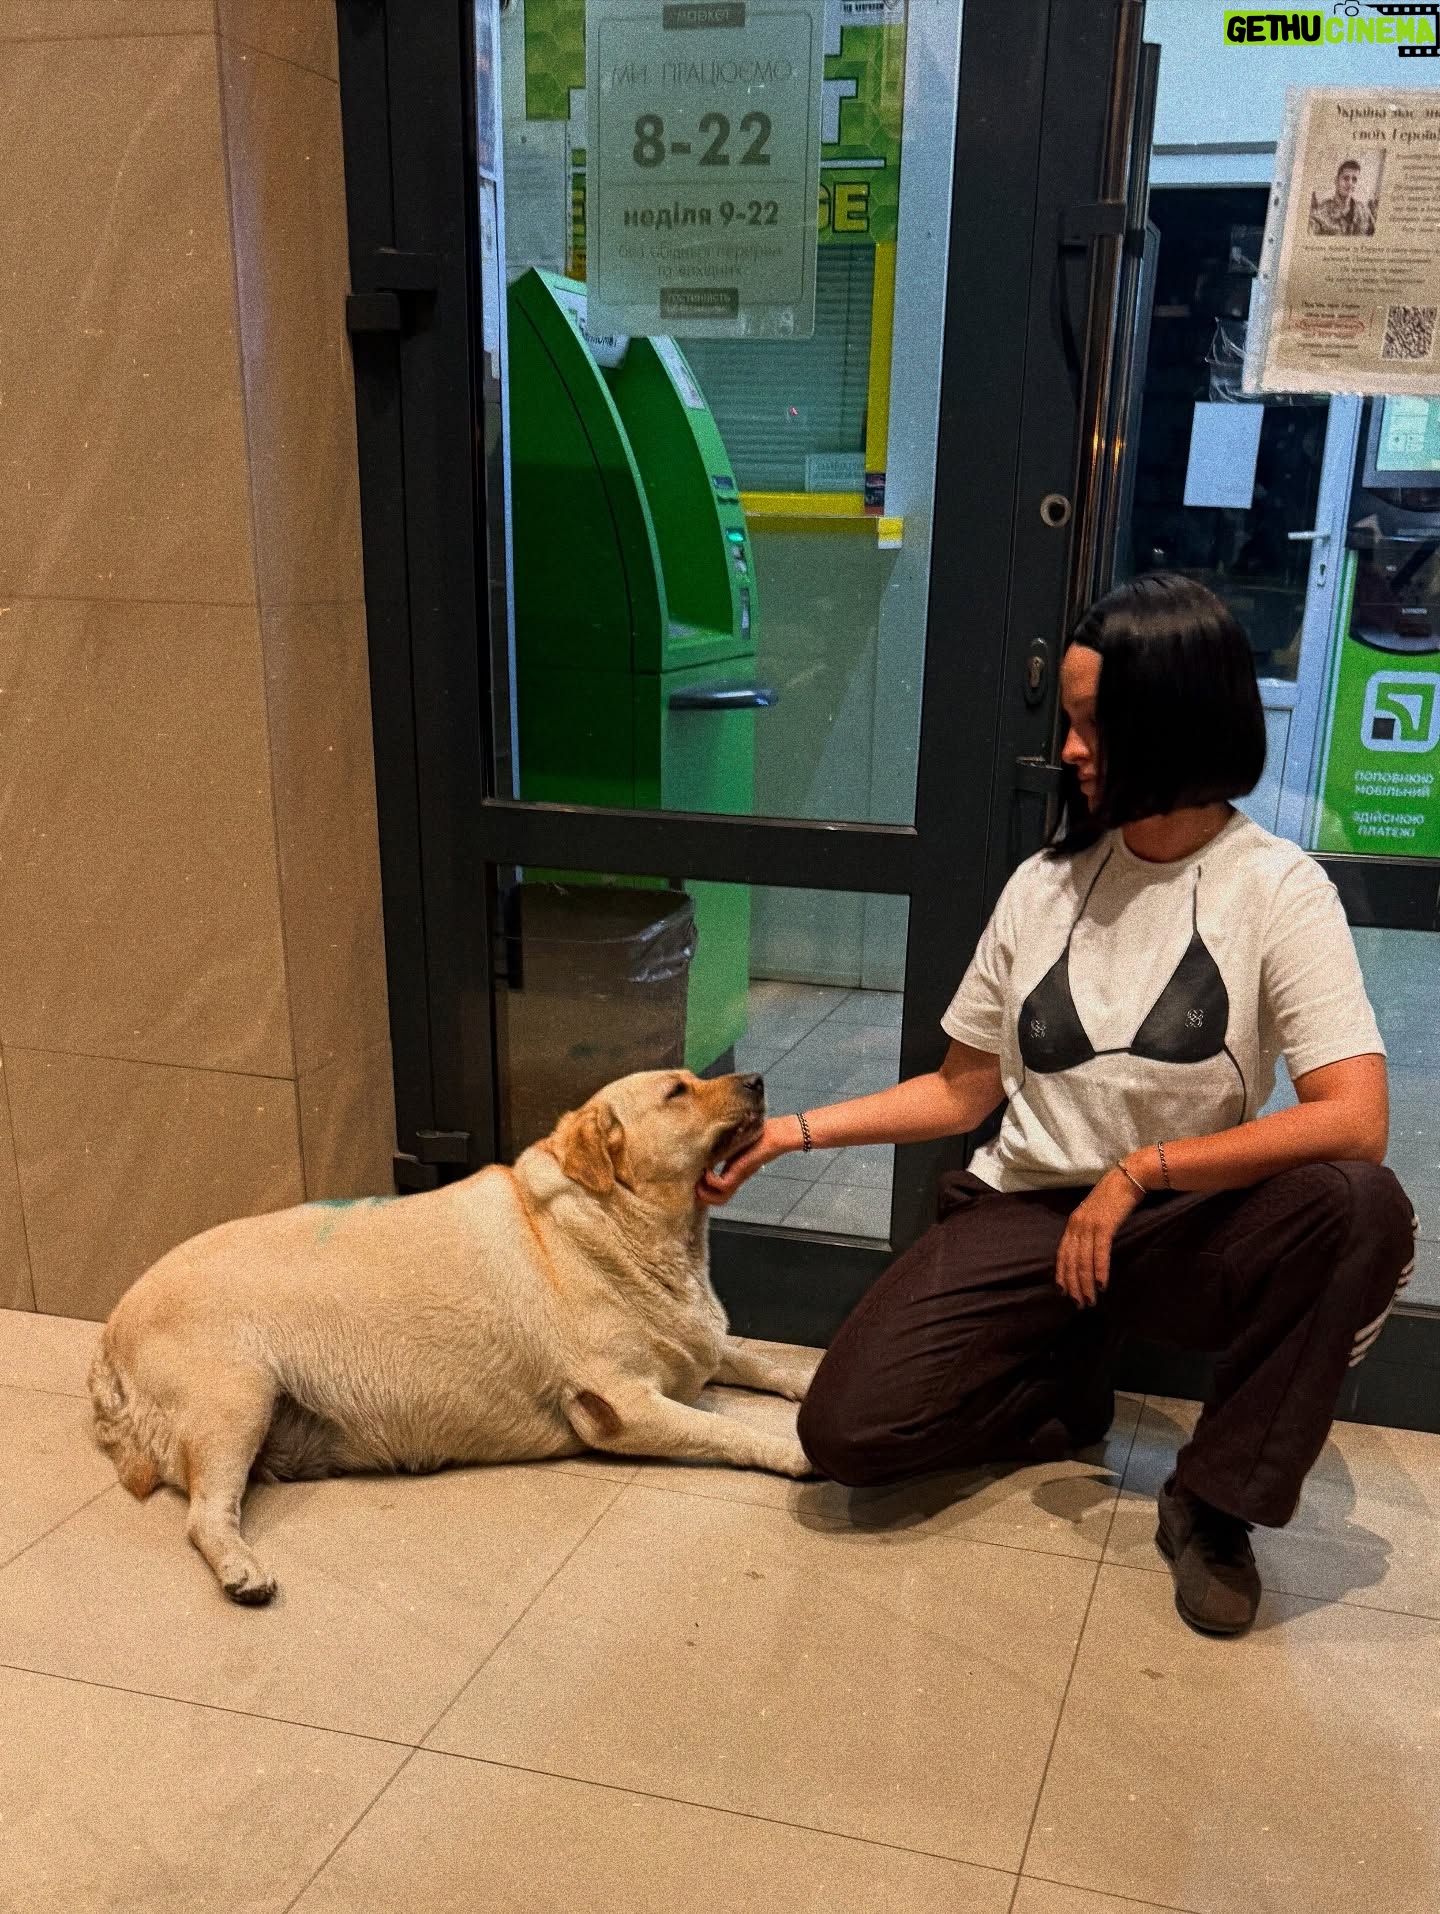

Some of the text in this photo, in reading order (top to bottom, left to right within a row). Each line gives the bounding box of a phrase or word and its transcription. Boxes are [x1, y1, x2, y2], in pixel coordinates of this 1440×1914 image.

[662, 58, 793, 87] ПРАЦЮЄМО
[632, 110, 772, 169] 8-22
[624, 200, 779, 230] неділя 9-22
[1354, 784, 1431, 798] МОБІЛЬНИЙ
